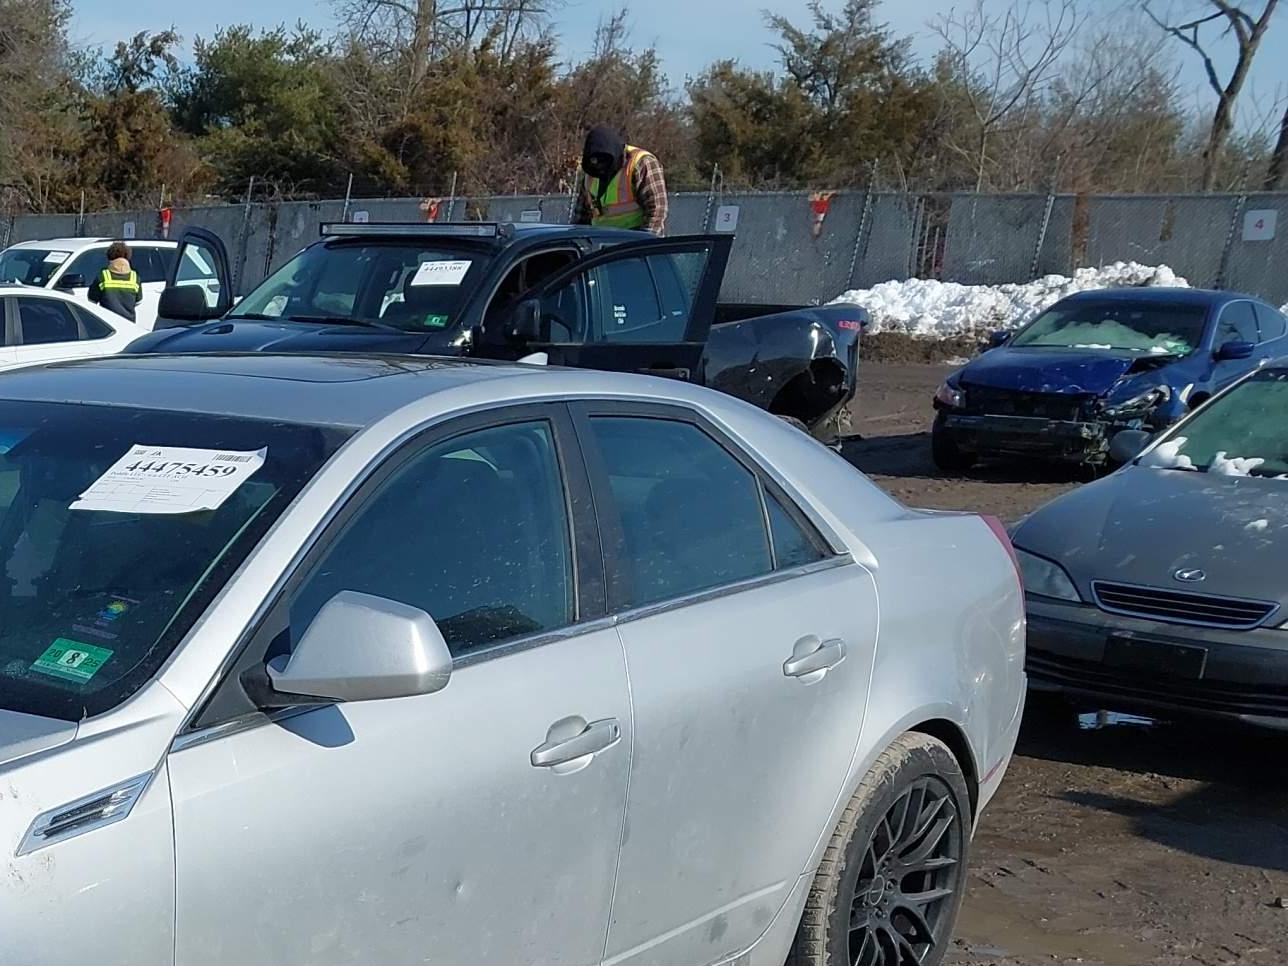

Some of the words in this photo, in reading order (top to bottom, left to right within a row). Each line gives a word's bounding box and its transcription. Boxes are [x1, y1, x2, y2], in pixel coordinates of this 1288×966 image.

[723, 213, 730, 223] 3
[1255, 218, 1264, 229] 4
[126, 460, 237, 477] 44475459
[66, 652, 81, 665] 8
